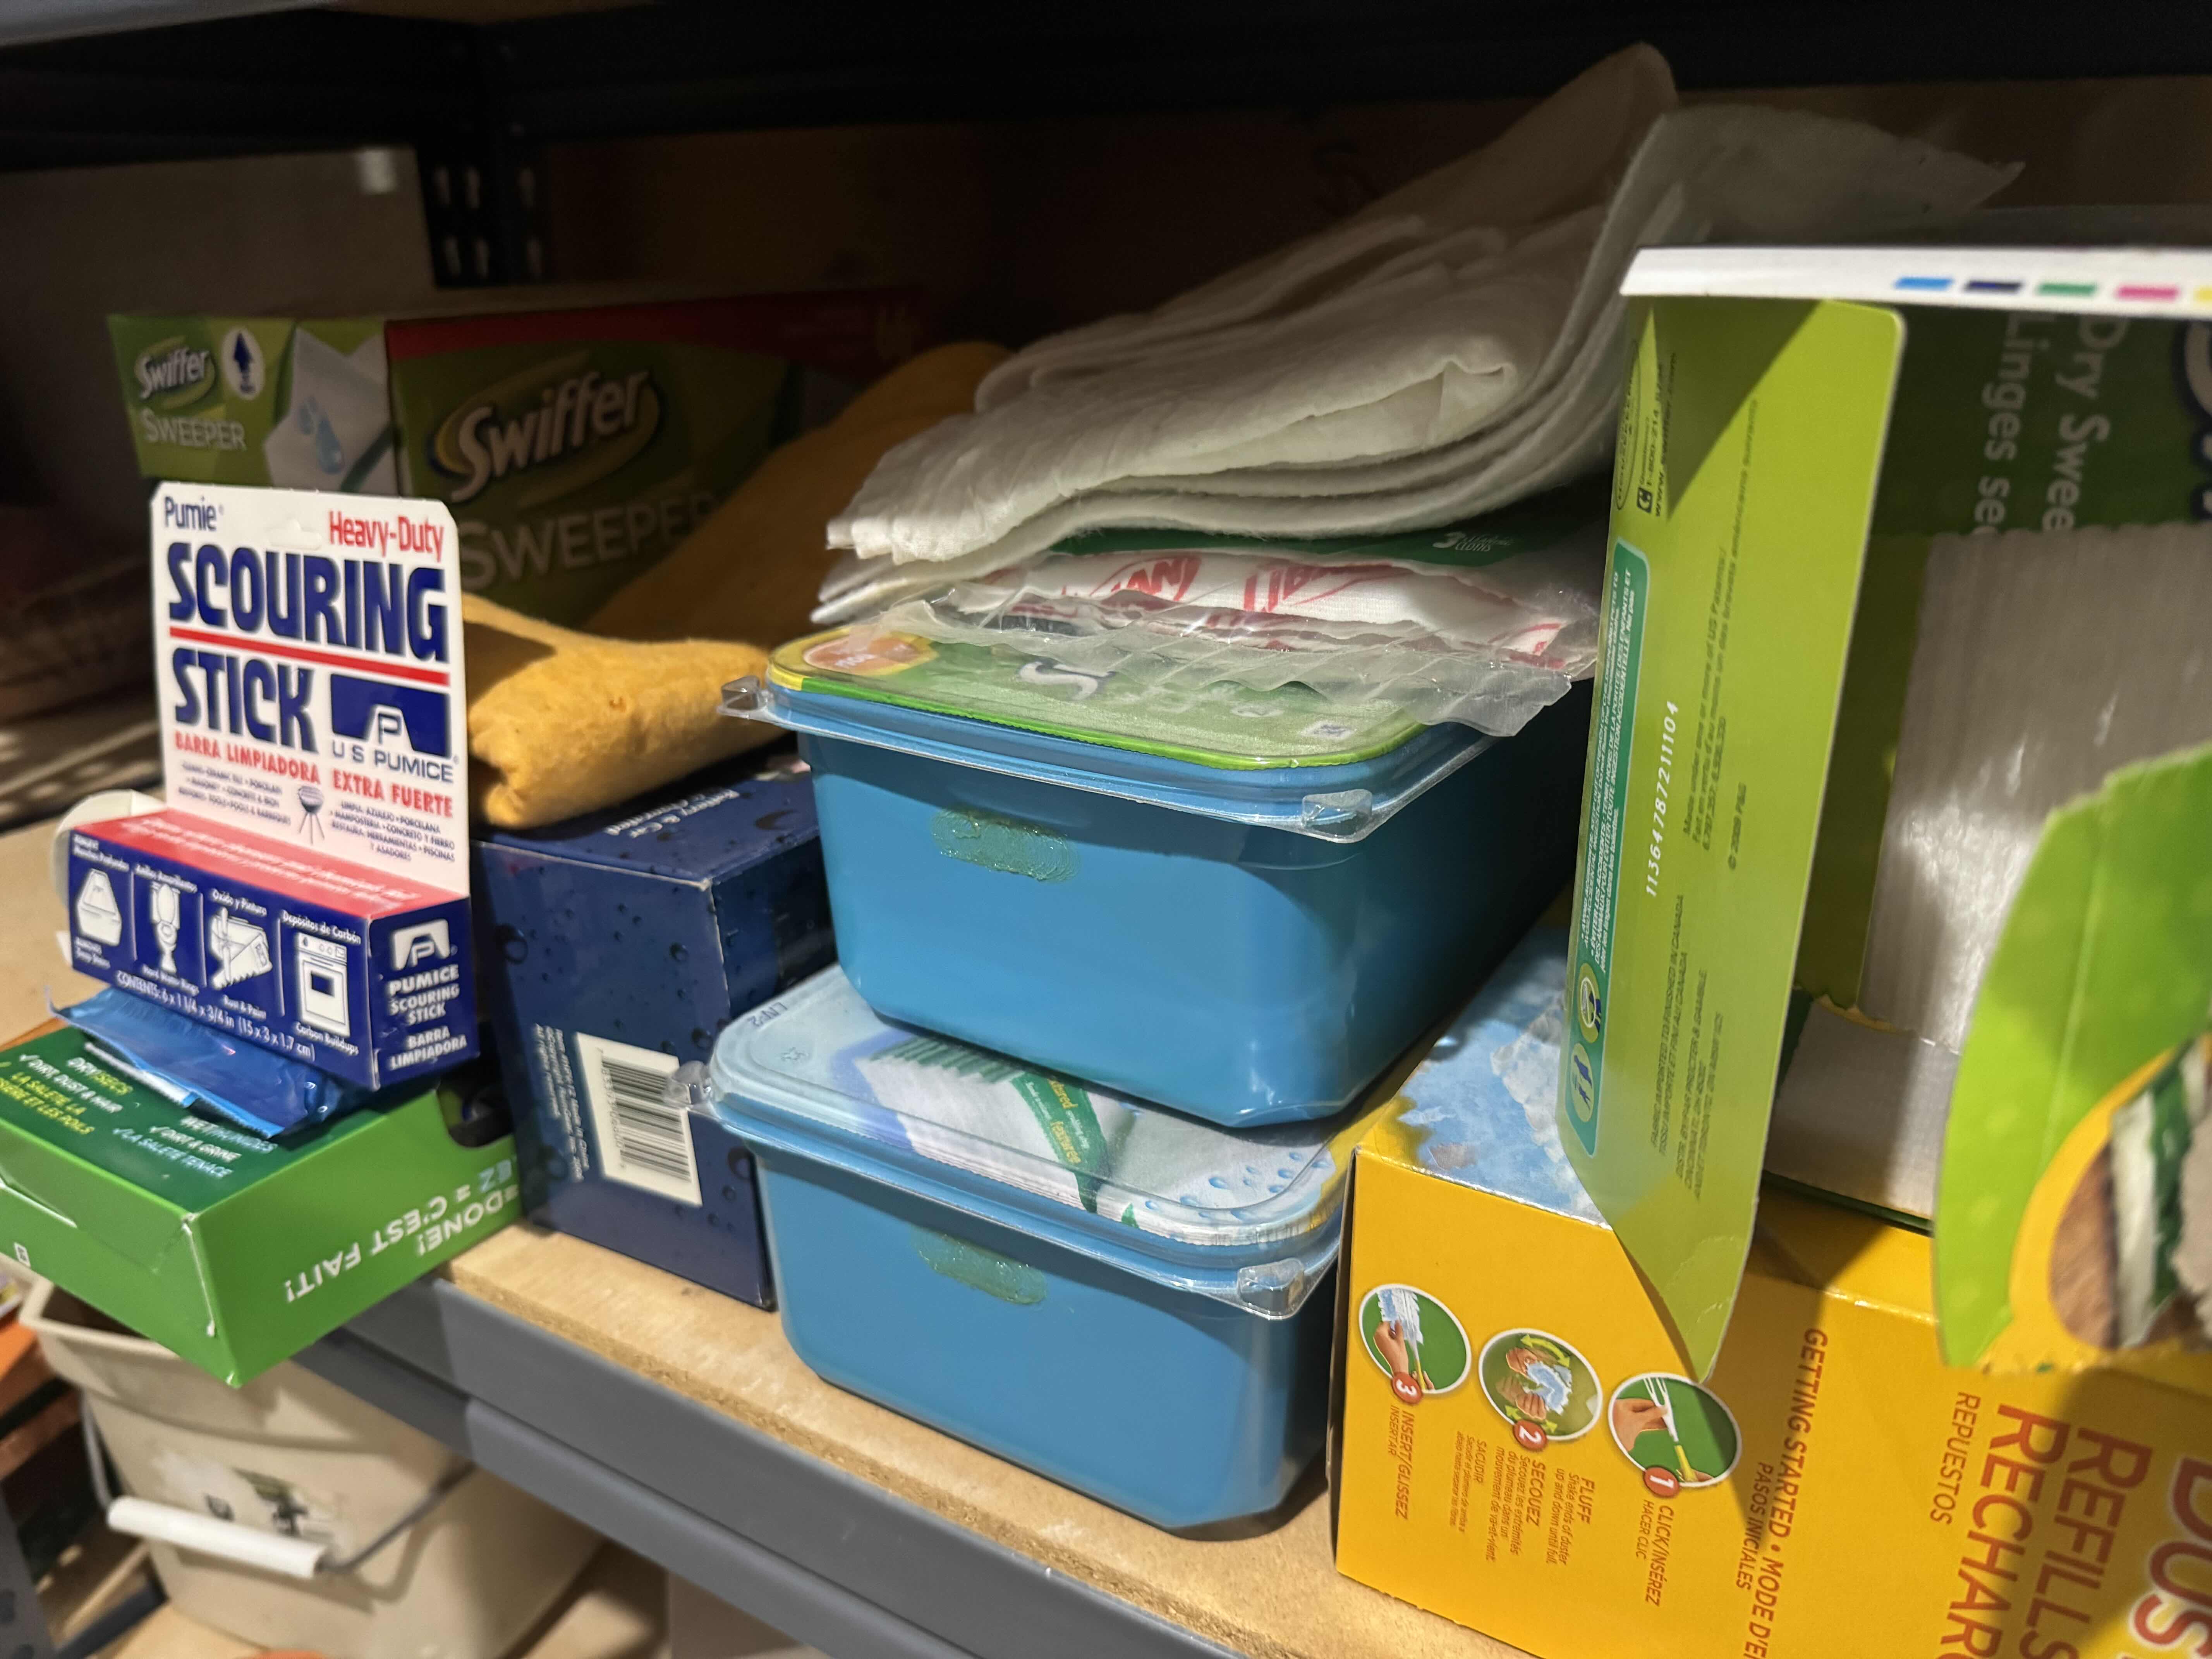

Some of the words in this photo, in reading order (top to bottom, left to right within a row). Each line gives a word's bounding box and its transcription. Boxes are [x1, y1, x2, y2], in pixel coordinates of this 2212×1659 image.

[140, 345, 210, 398] Swiffer
[2056, 314, 2130, 400] Dry
[1982, 313, 2057, 460] Linges
[141, 415, 247, 451] SWEEPER
[451, 371, 648, 503] Swiffer
[164, 498, 217, 531] Pumie
[330, 510, 444, 563] Heavy-Duty
[168, 542, 450, 664] SCOURING
[173, 648, 319, 754] STICK
[175, 731, 220, 758] BARRA
[227, 743, 321, 784] LIMPIADORA
[333, 740, 344, 758] U
[352, 745, 364, 763] S
[374, 749, 453, 783] PUMICE
[333, 769, 384, 800] EXTRA
[392, 783, 452, 817] FUERTE
[1647, 701, 1678, 896] 11364787211104
[282, 910, 319, 933] Depósitos
[321, 922, 331, 935] de
[331, 925, 361, 945] Carbón
[1671, 895, 1683, 949] CANADA
[388, 964, 459, 995] PUMICE
[389, 983, 460, 1015] SCOURING
[407, 1002, 445, 1025] STICK
[295, 1022, 324, 1042] Carbon
[325, 1032, 359, 1056] Buildups
[390, 1034, 467, 1070] LIMPIADORA
[407, 1026, 450, 1048] BARRA
[370, 1196, 448, 1256] C'EST
[419, 1190, 503, 1255] DONE!
[285, 1242, 362, 1303] FAIT!
[1395, 1379, 1417, 1396] 3
[1788, 1327, 1828, 1435] GETTING
[1388, 1405, 1399, 1456] INSERTAR
[1518, 1425, 1542, 1444] 2
[1395, 1409, 1415, 1520] INSERT/GLISSEZ
[1474, 1439, 1487, 1483] SACUDIR
[1491, 1446, 1505, 1499] mouvement
[1508, 1451, 1518, 1463] du
[1517, 1455, 1530, 1492] Secouez
[1556, 1468, 1565, 1480] up
[1930, 1391, 1981, 1525] REPUESTOS
[1504, 1464, 1516, 1502] plumeau
[1515, 1496, 1525, 1507] les
[1526, 1460, 1546, 1527] SECOUEZ
[1553, 1486, 1563, 1499] and
[1565, 1472, 1580, 1501] Shake
[1578, 1477, 1595, 1525] FLUFF
[1650, 1474, 1674, 1489] 1
[1750, 1461, 1774, 1520] PASOS
[1769, 1438, 1807, 1539] STARTED
[1491, 1500, 1501, 1512] de
[1502, 1504, 1512, 1524] dans
[1551, 1501, 1561, 1524] down
[1564, 1501, 1573, 1524] ends
[1640, 1498, 1654, 1535] HACER
[1500, 1526, 1509, 1537] un
[1510, 1508, 1524, 1556] extrémités
[1558, 1538, 1569, 1565] duster
[1561, 1525, 1571, 1537] of
[1636, 1535, 1649, 1560] CLIC
[1645, 1505, 1674, 1607] CLICK/INSÉREZ
[1736, 1519, 1764, 1591] INICIALES
[1751, 1554, 1784, 1623] MODE
[1744, 1629, 1771, 1659] D'E
